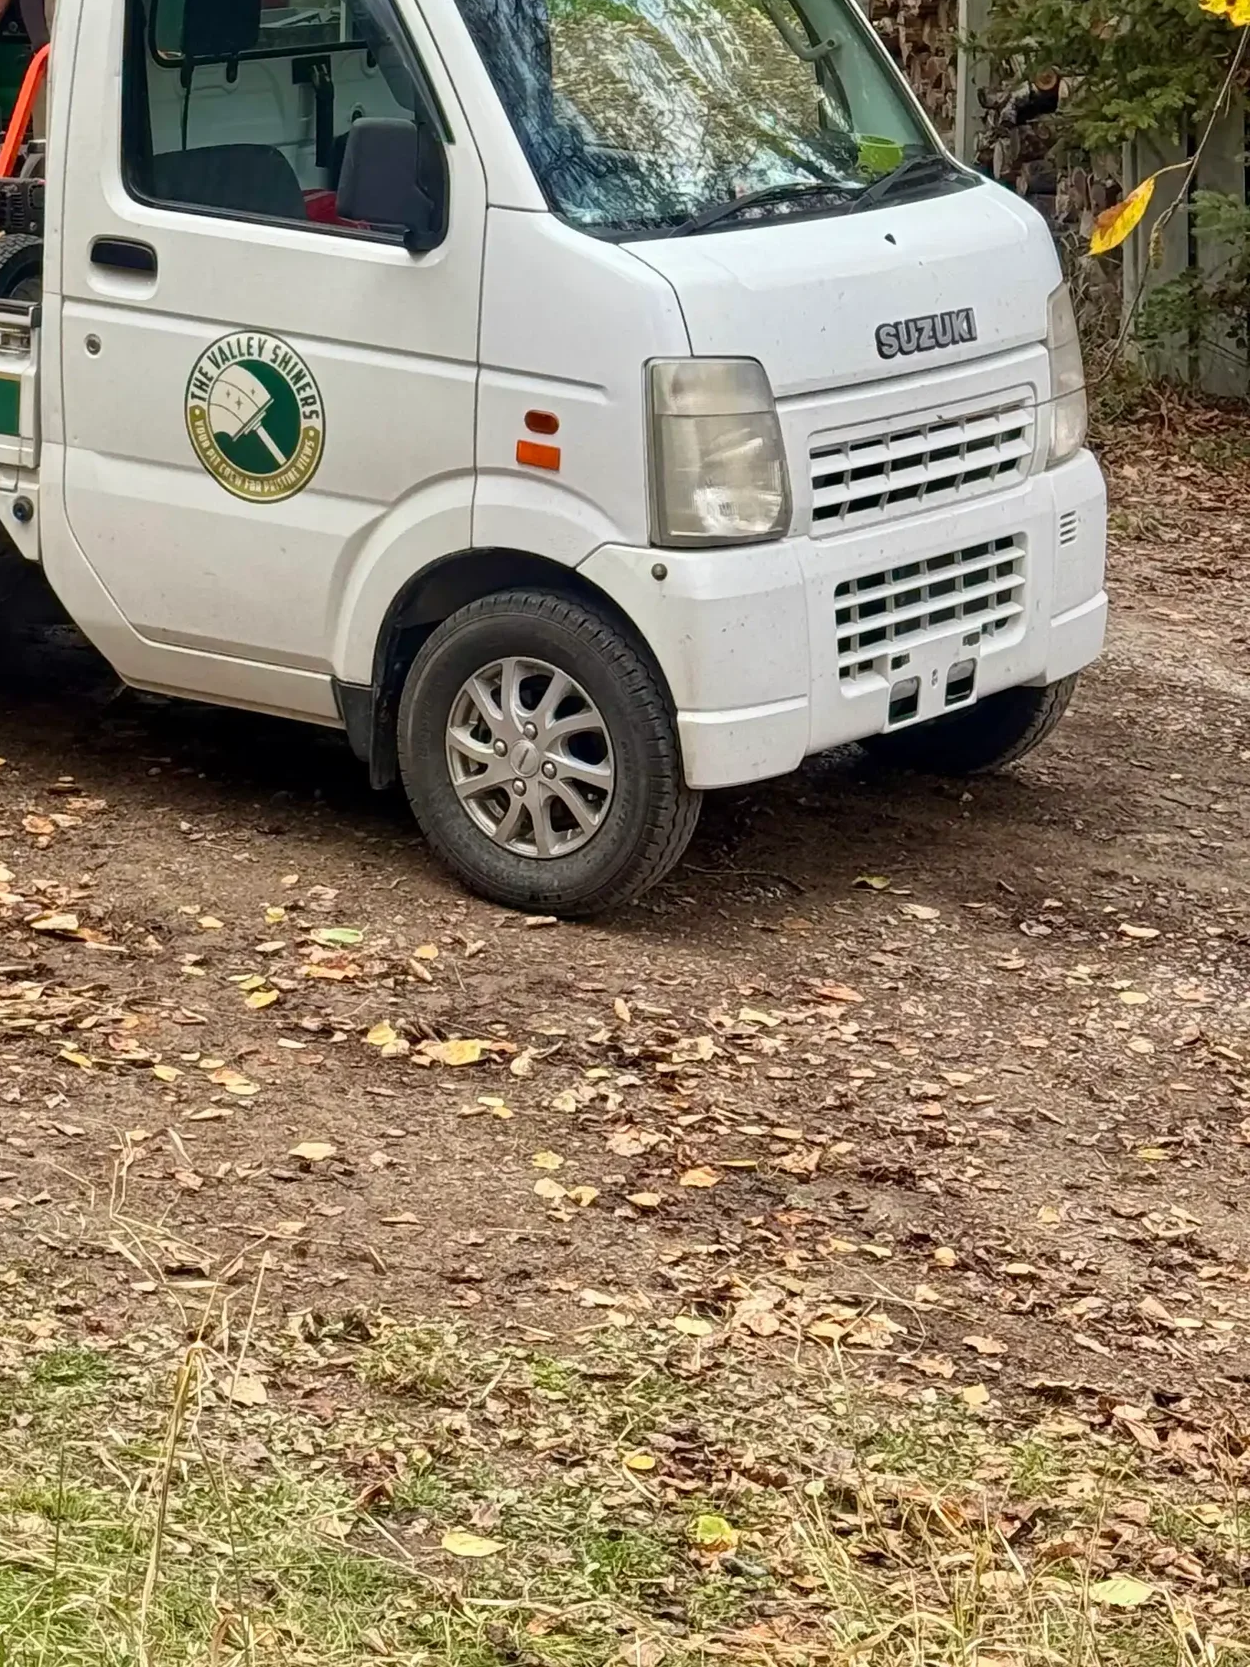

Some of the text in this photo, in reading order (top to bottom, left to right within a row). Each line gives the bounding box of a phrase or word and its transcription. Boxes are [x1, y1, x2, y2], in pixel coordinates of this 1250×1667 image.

[875, 307, 978, 359] SUZUKI
[190, 336, 320, 420] THE VALLEY SHINERS
[194, 419, 316, 492] YOUR PIT CREW FOR PRISTINE VIEWS
